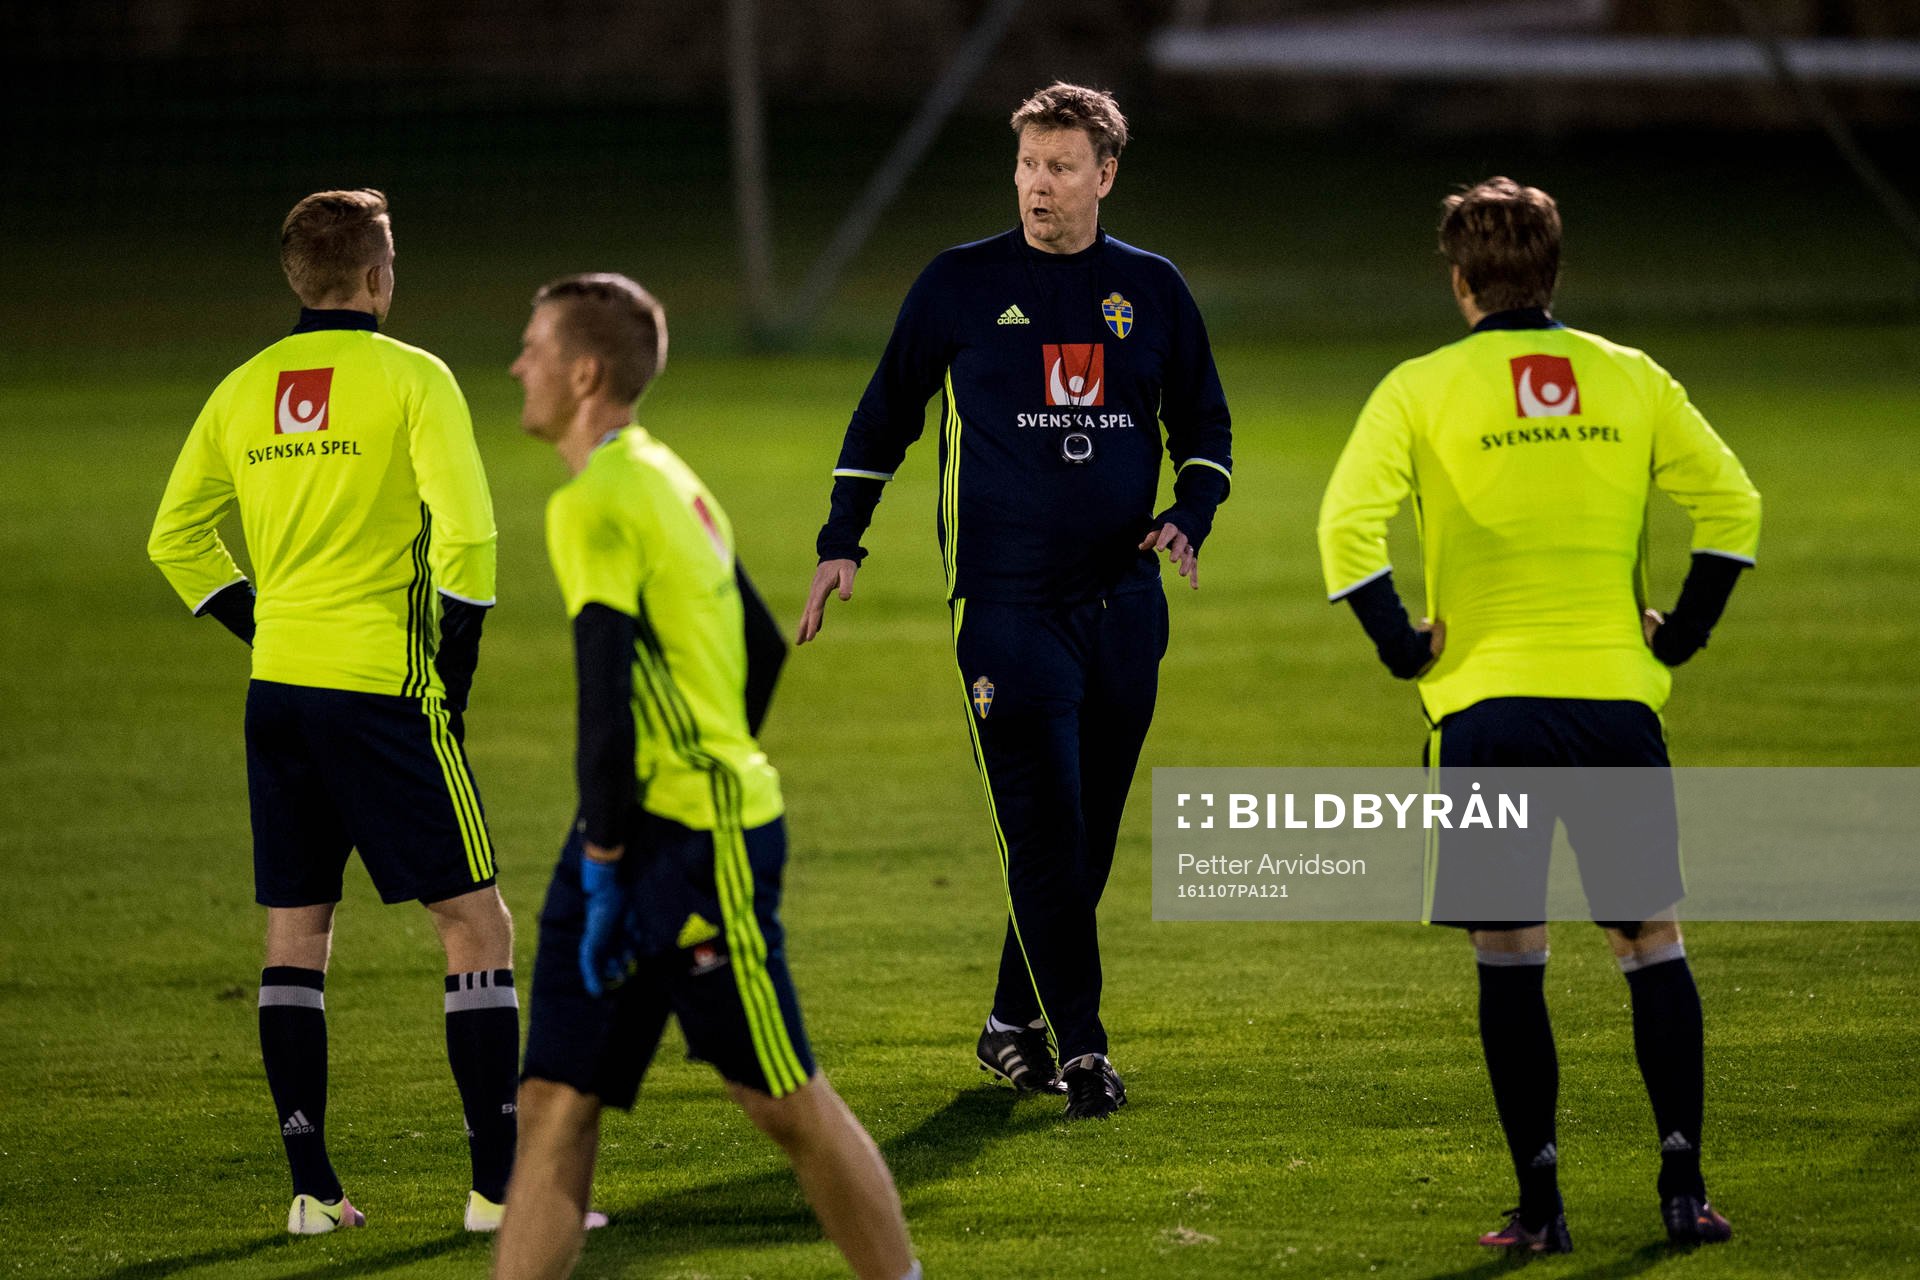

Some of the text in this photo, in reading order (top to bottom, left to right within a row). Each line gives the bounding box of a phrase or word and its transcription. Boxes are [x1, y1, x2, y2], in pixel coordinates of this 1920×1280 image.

[997, 316, 1030, 325] adidas
[1099, 414, 1134, 428] SPEL
[1481, 426, 1622, 450] SVENSKA SPEL
[248, 441, 361, 465] SVENSKA SPEL
